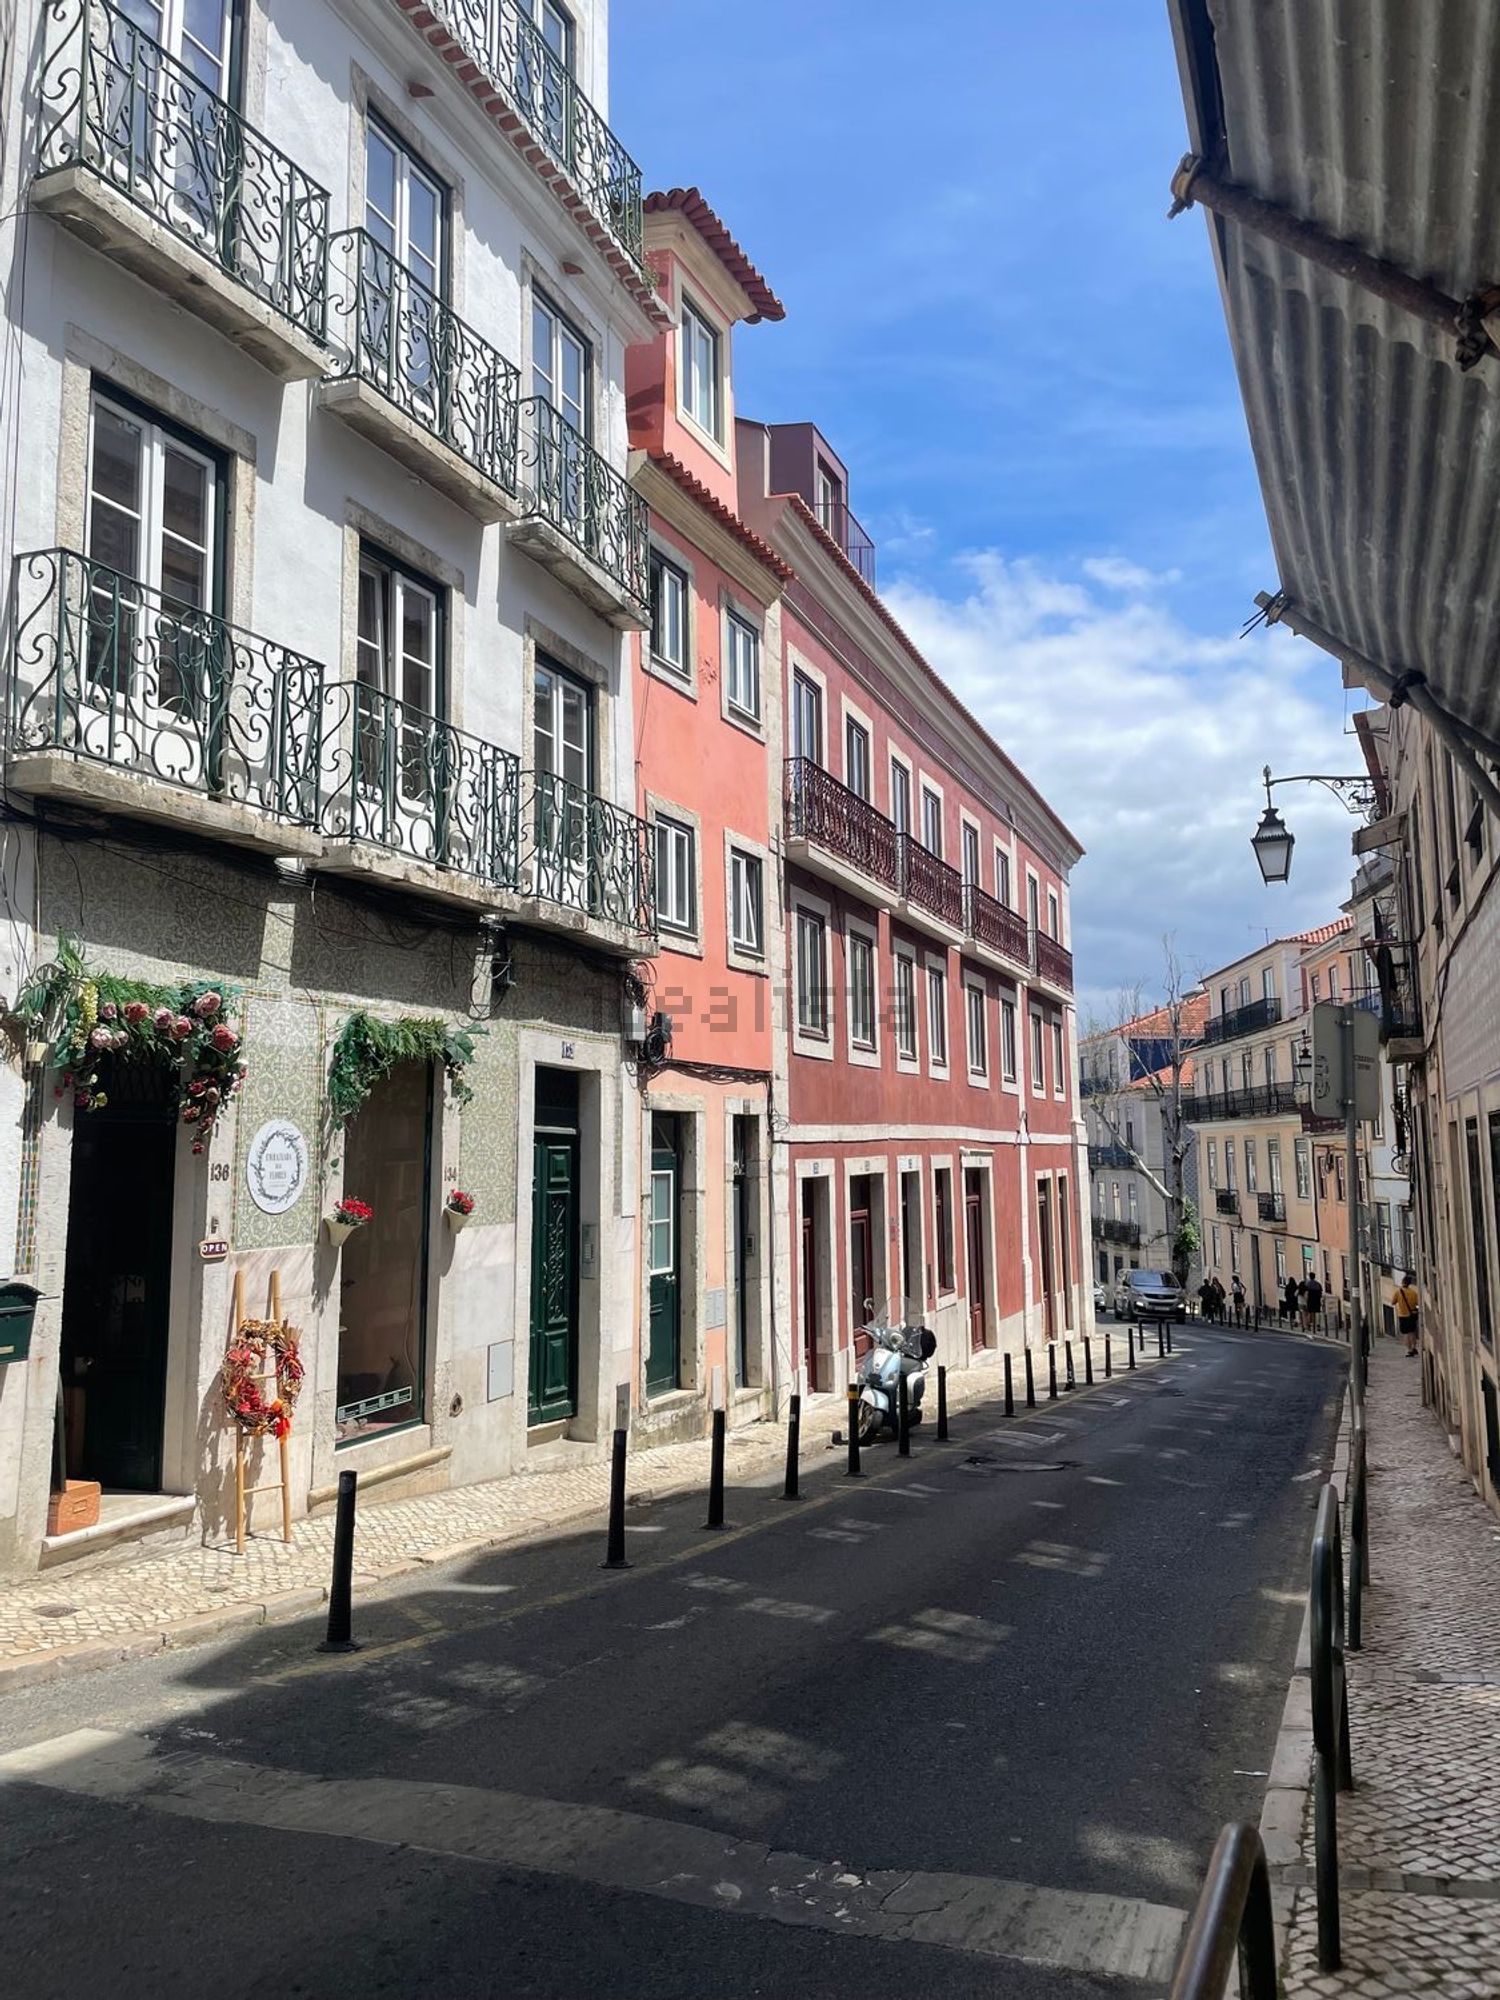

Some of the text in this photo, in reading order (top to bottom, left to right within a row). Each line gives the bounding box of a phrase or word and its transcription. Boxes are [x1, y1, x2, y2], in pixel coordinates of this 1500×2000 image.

[210, 1163, 230, 1181] 136
[444, 1166, 457, 1182] 134
[202, 1244, 228, 1253] OPEN
